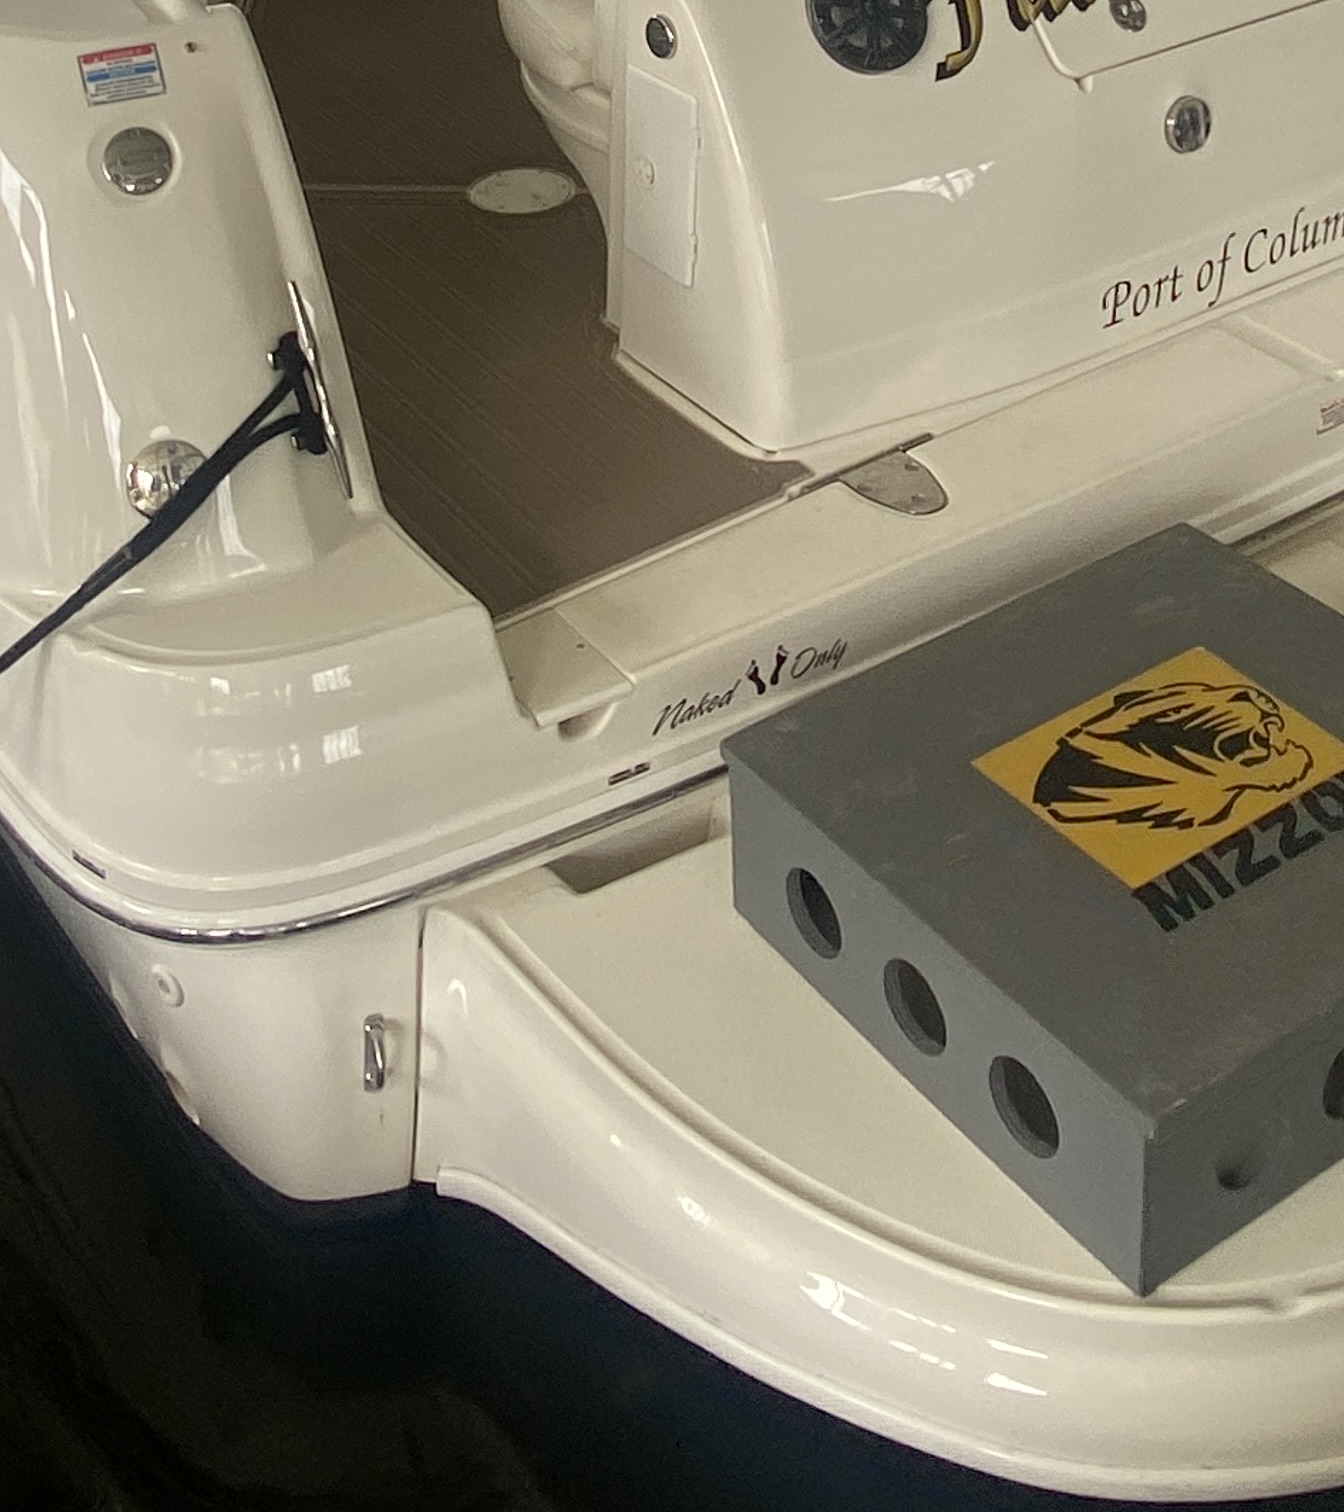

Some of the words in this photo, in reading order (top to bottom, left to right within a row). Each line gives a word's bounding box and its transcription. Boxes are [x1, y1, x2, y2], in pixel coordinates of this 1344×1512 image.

[1102, 264, 1184, 329] Port
[1196, 231, 1236, 308] of
[652, 678, 742, 737] Naked
[789, 638, 848, 679] Only
